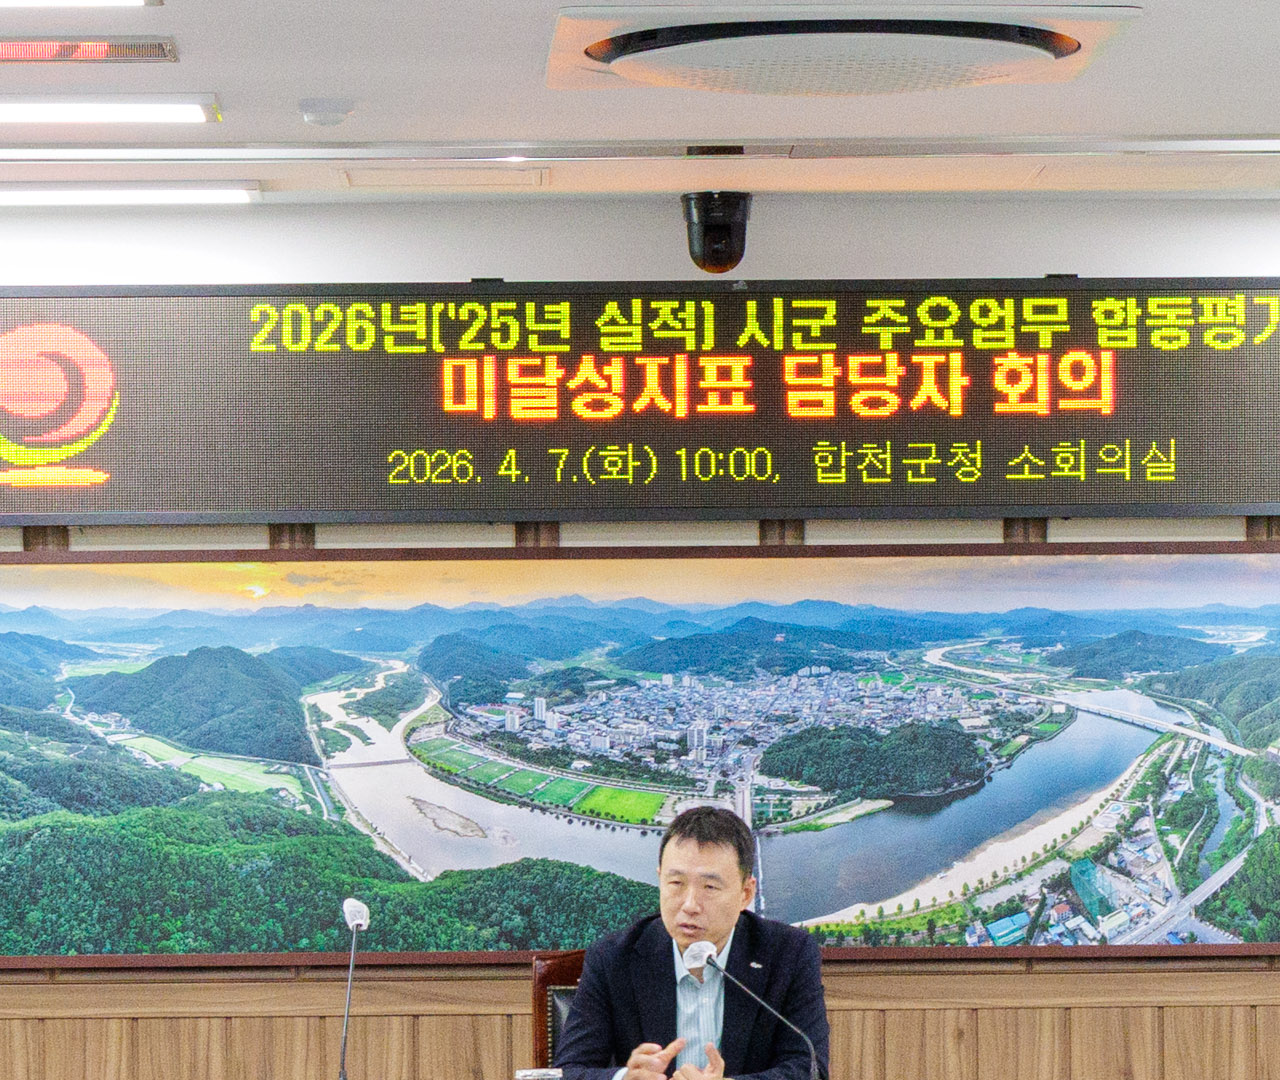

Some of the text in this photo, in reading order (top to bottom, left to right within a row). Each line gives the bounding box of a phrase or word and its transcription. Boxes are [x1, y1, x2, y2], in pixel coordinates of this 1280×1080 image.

[595, 298, 715, 352] 실적)
[737, 297, 837, 350] 시군
[861, 296, 1070, 350] 주요업무
[441, 350, 1115, 420] 미달성지표 담당자 회의
[387, 448, 482, 484] 2026.
[497, 448, 529, 483] 4.
[675, 447, 781, 484] 10:00,
[812, 440, 983, 483] 합천군청
[1005, 438, 1177, 481] 소회의실
